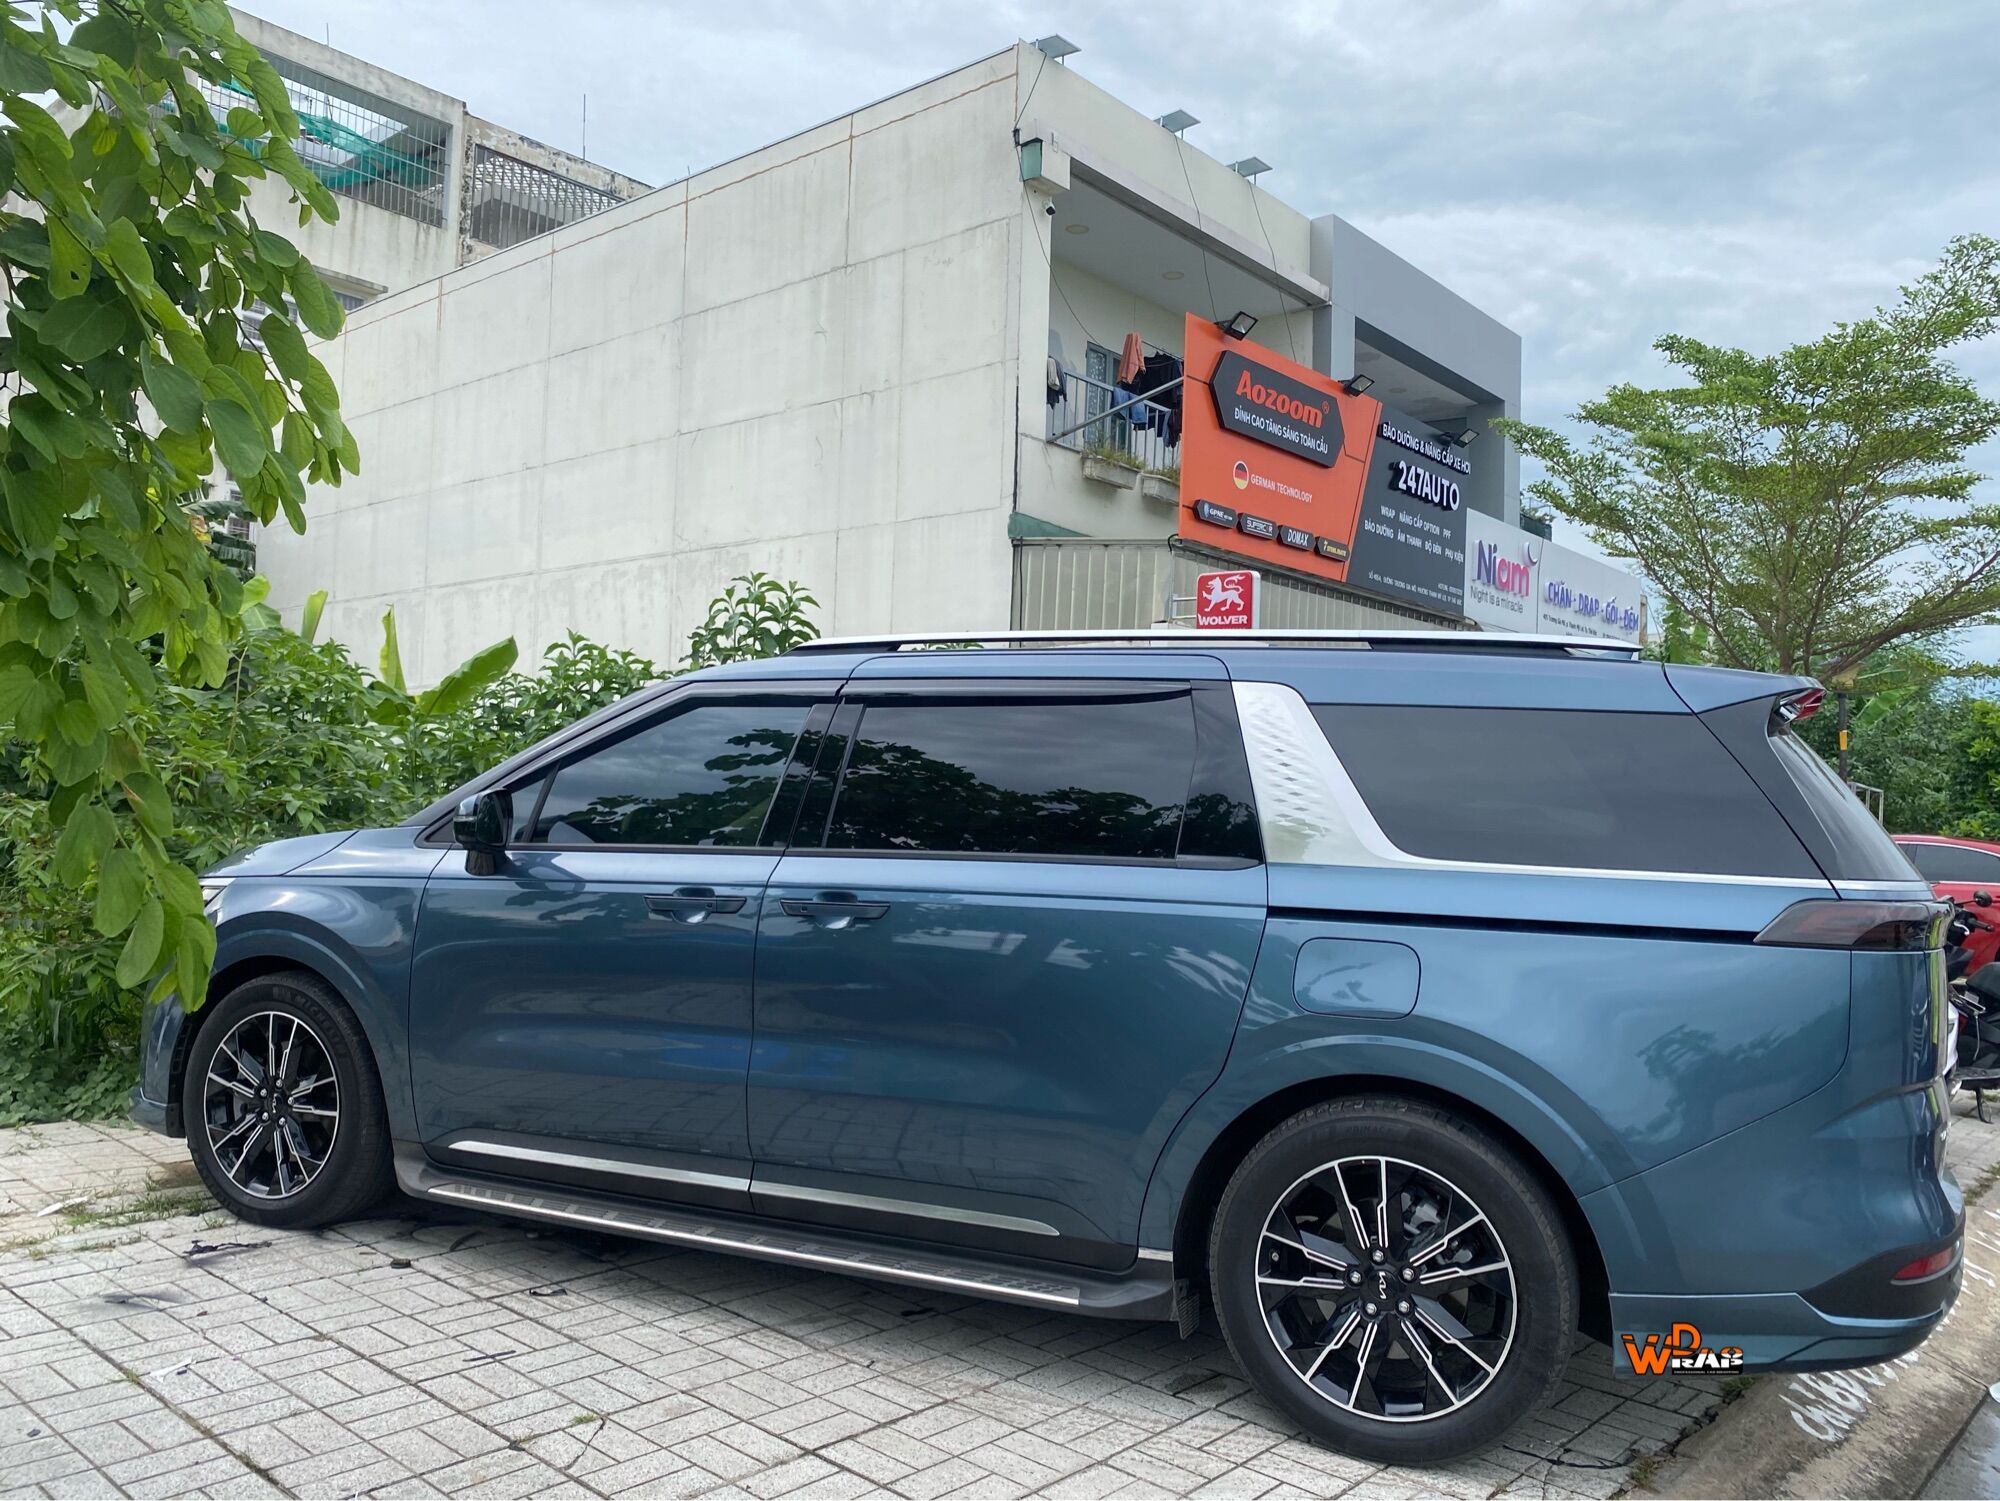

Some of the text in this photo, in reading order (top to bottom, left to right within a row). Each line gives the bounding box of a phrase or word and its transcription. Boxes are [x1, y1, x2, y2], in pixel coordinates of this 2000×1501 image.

[1235, 370, 1323, 428] Aozoom
[1251, 414, 1265, 430] CAO
[1382, 421, 1397, 440] BẢO
[1419, 441, 1425, 454] &
[1453, 456, 1461, 471] XE
[1250, 474, 1313, 503] GERMAN TECHNOLOGY
[1398, 460, 1460, 511] 247AUTO
[1380, 505, 1396, 519] WRAP
[1423, 521, 1440, 536] OPTION
[1442, 528, 1452, 539] PPF
[1287, 529, 1309, 547] DOMAX
[1406, 533, 1422, 548] THANH
[1476, 539, 1530, 597] Niam
[1470, 585, 1489, 604] Night
[1489, 591, 1496, 605] is
[1500, 597, 1524, 614] miracle
[1546, 580, 1572, 609] CHĂN
[1578, 592, 1600, 616] DRAP
[1197, 613, 1248, 626] WOLVER
